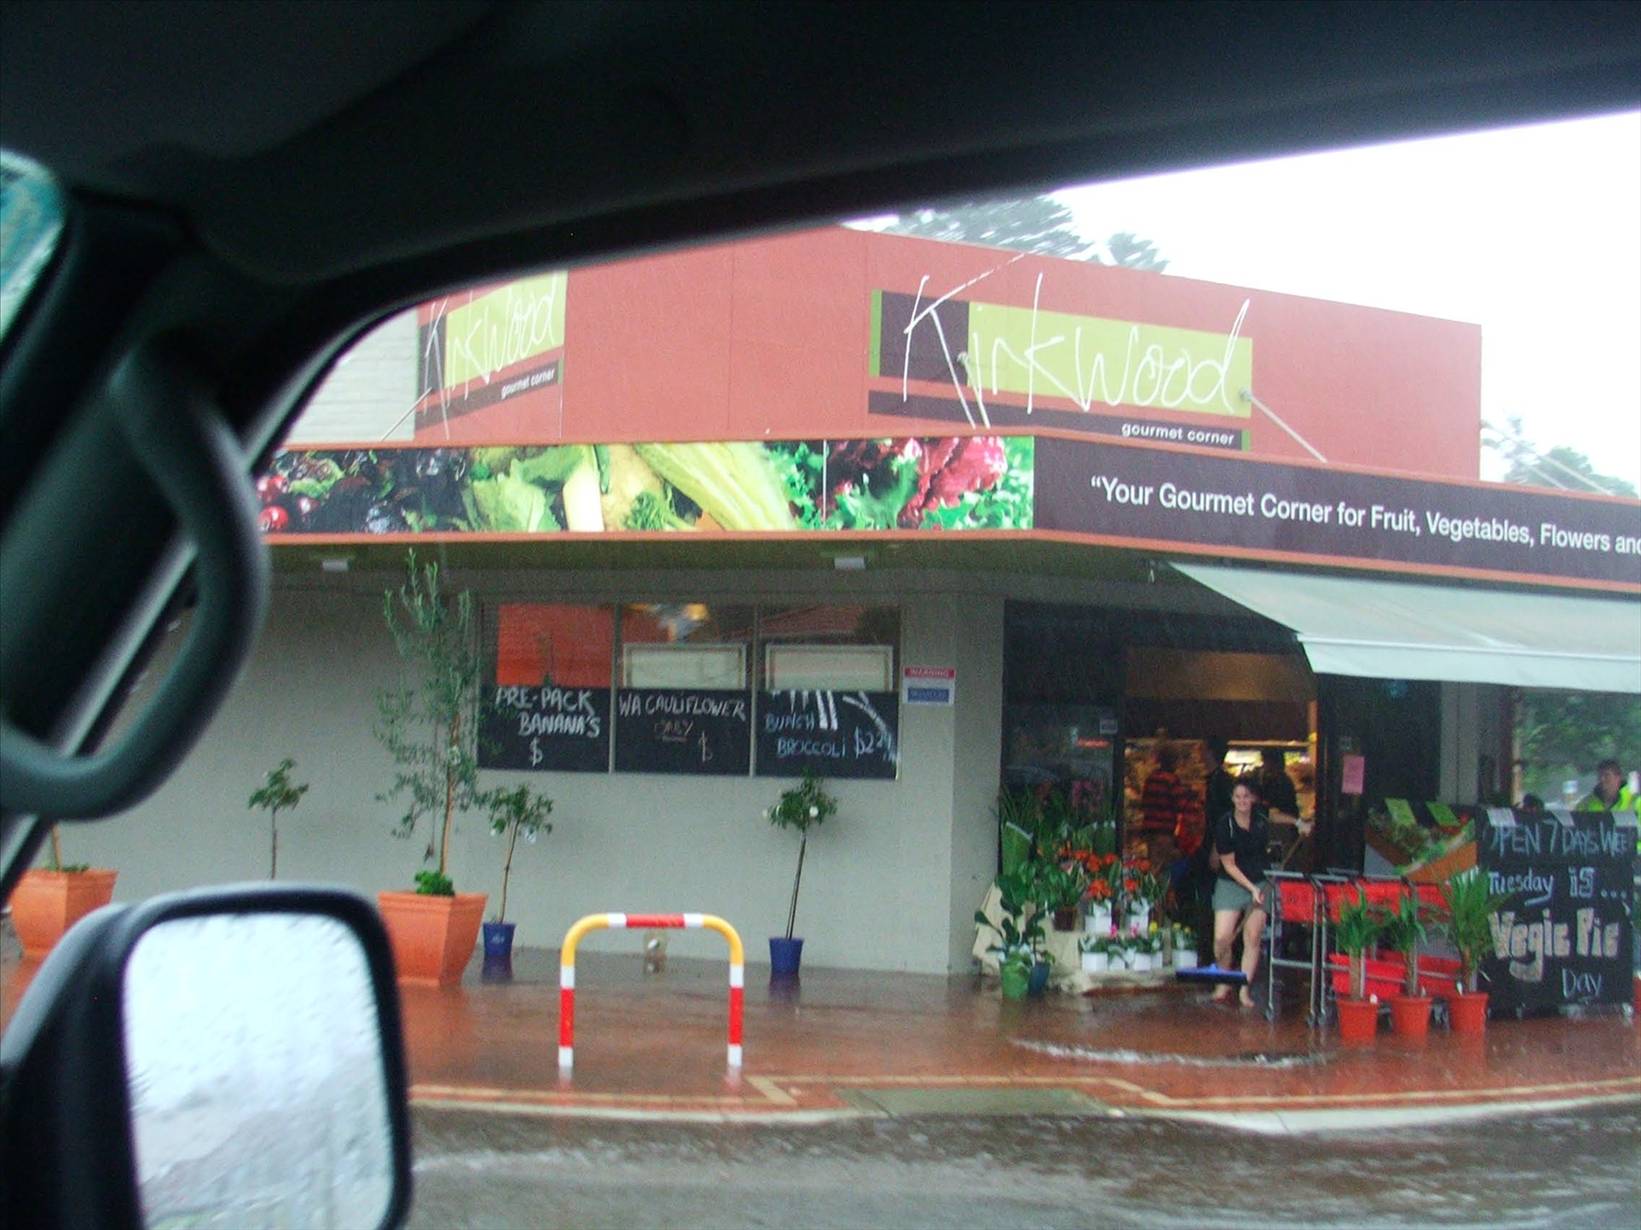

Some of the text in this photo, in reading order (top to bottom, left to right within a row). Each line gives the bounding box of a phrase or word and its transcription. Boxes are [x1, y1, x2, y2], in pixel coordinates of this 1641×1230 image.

[501, 368, 555, 400] gourmet corner
[1121, 423, 1235, 445] gourmet corner
[1159, 483, 1254, 516] Gourmet
[1261, 493, 1332, 524] Corner
[1337, 501, 1365, 527] for
[1371, 505, 1421, 536] Fruit,
[1426, 511, 1535, 548] Vegetables,
[1540, 523, 1610, 551] Flowers
[495, 686, 595, 717] PRE-PACK
[619, 693, 641, 717] WA
[518, 711, 600, 738] BANANA'S
[1542, 819, 1558, 853] 7
[1488, 866, 1554, 907] Tuesday
[1562, 966, 1603, 999] Day
